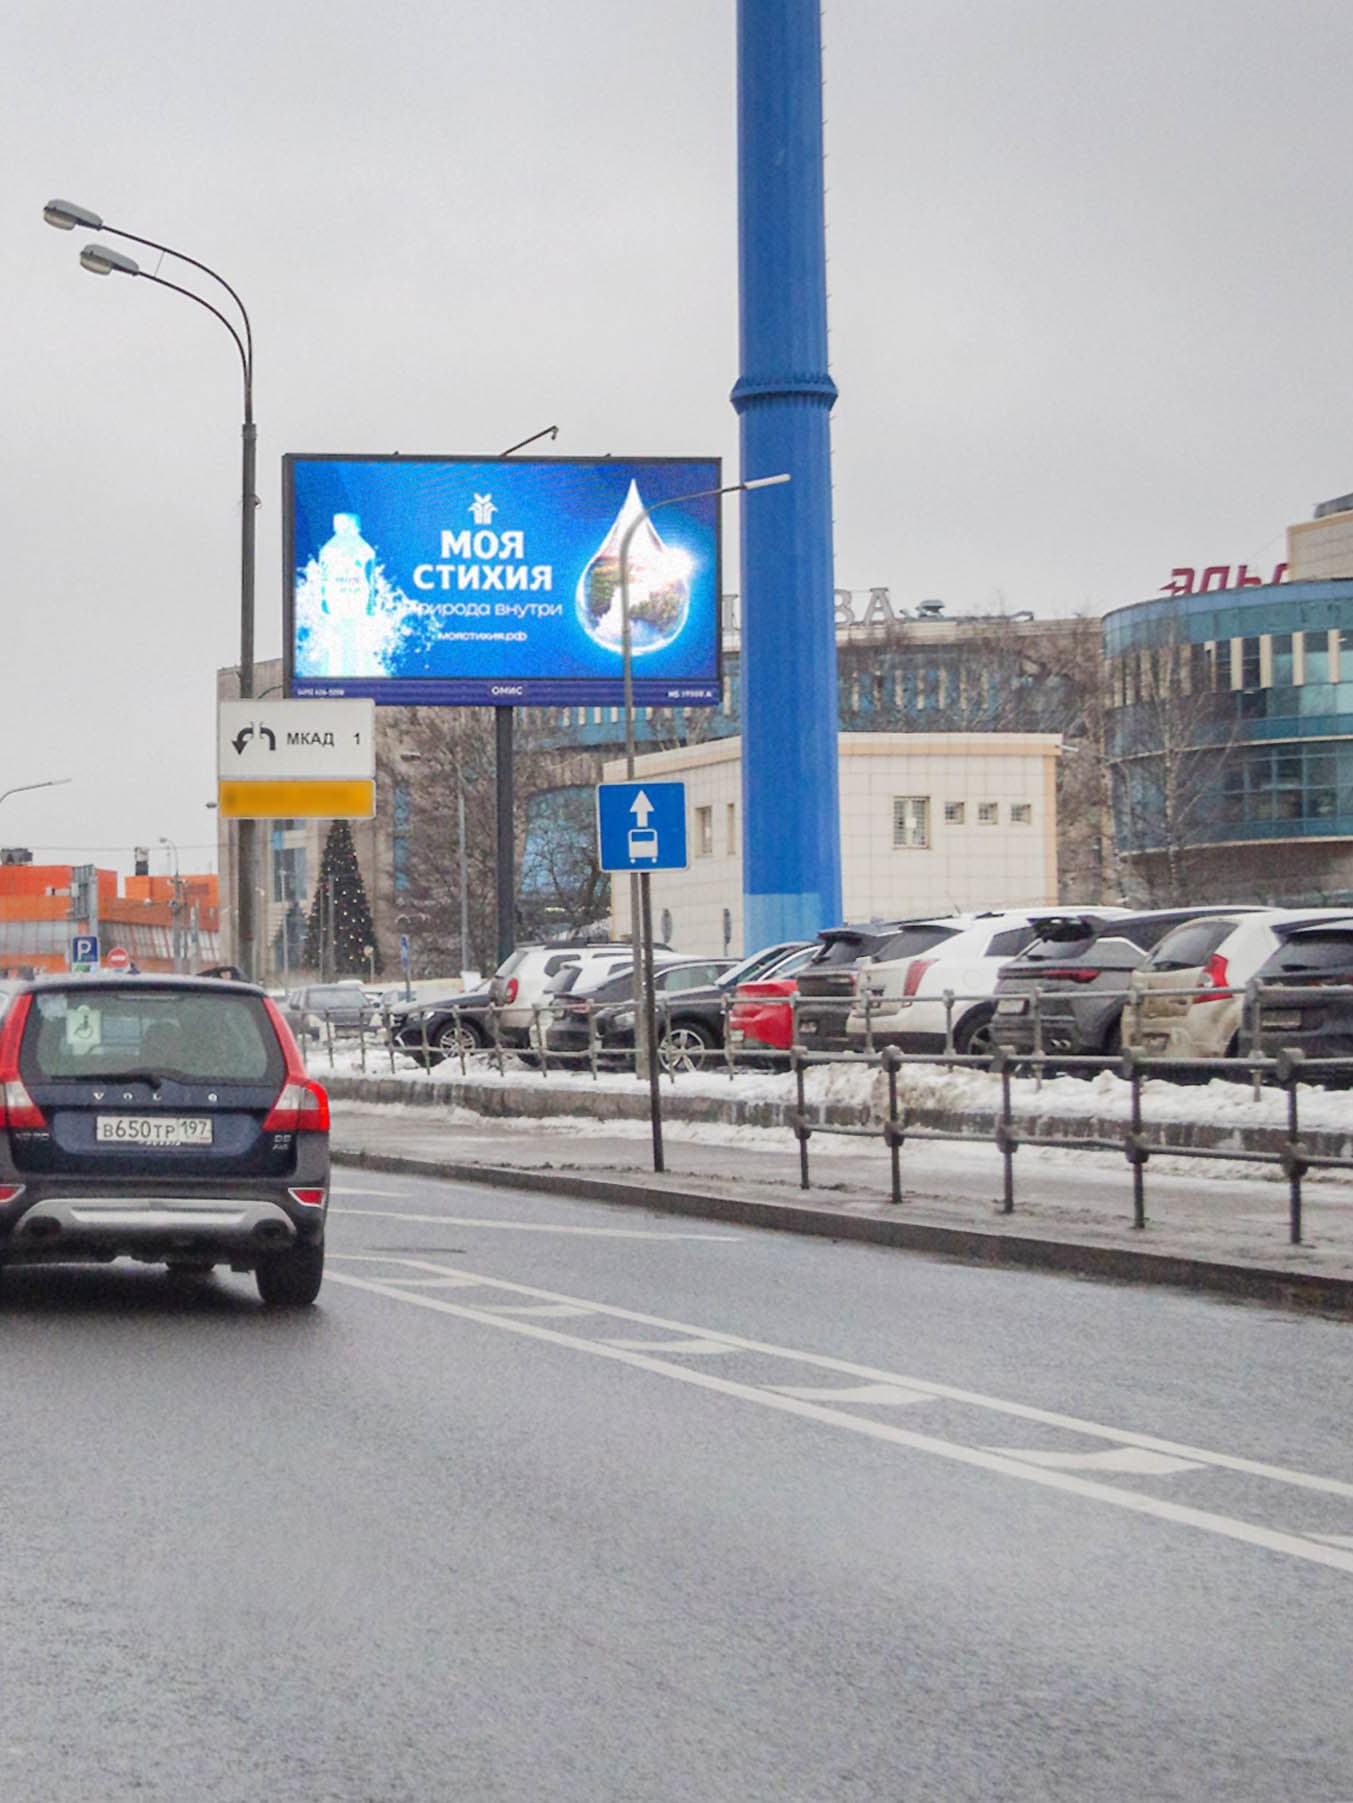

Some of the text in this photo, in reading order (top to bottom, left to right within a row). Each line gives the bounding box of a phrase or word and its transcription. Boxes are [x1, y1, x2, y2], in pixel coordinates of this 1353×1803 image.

[440, 530, 524, 559] МОЯ
[412, 564, 553, 591] СТИХИЯ
[409, 602, 563, 618] рирода внутри
[491, 686, 523, 695] ОМИС
[286, 732, 360, 747] МКАД 1
[77, 941, 91, 961] P
